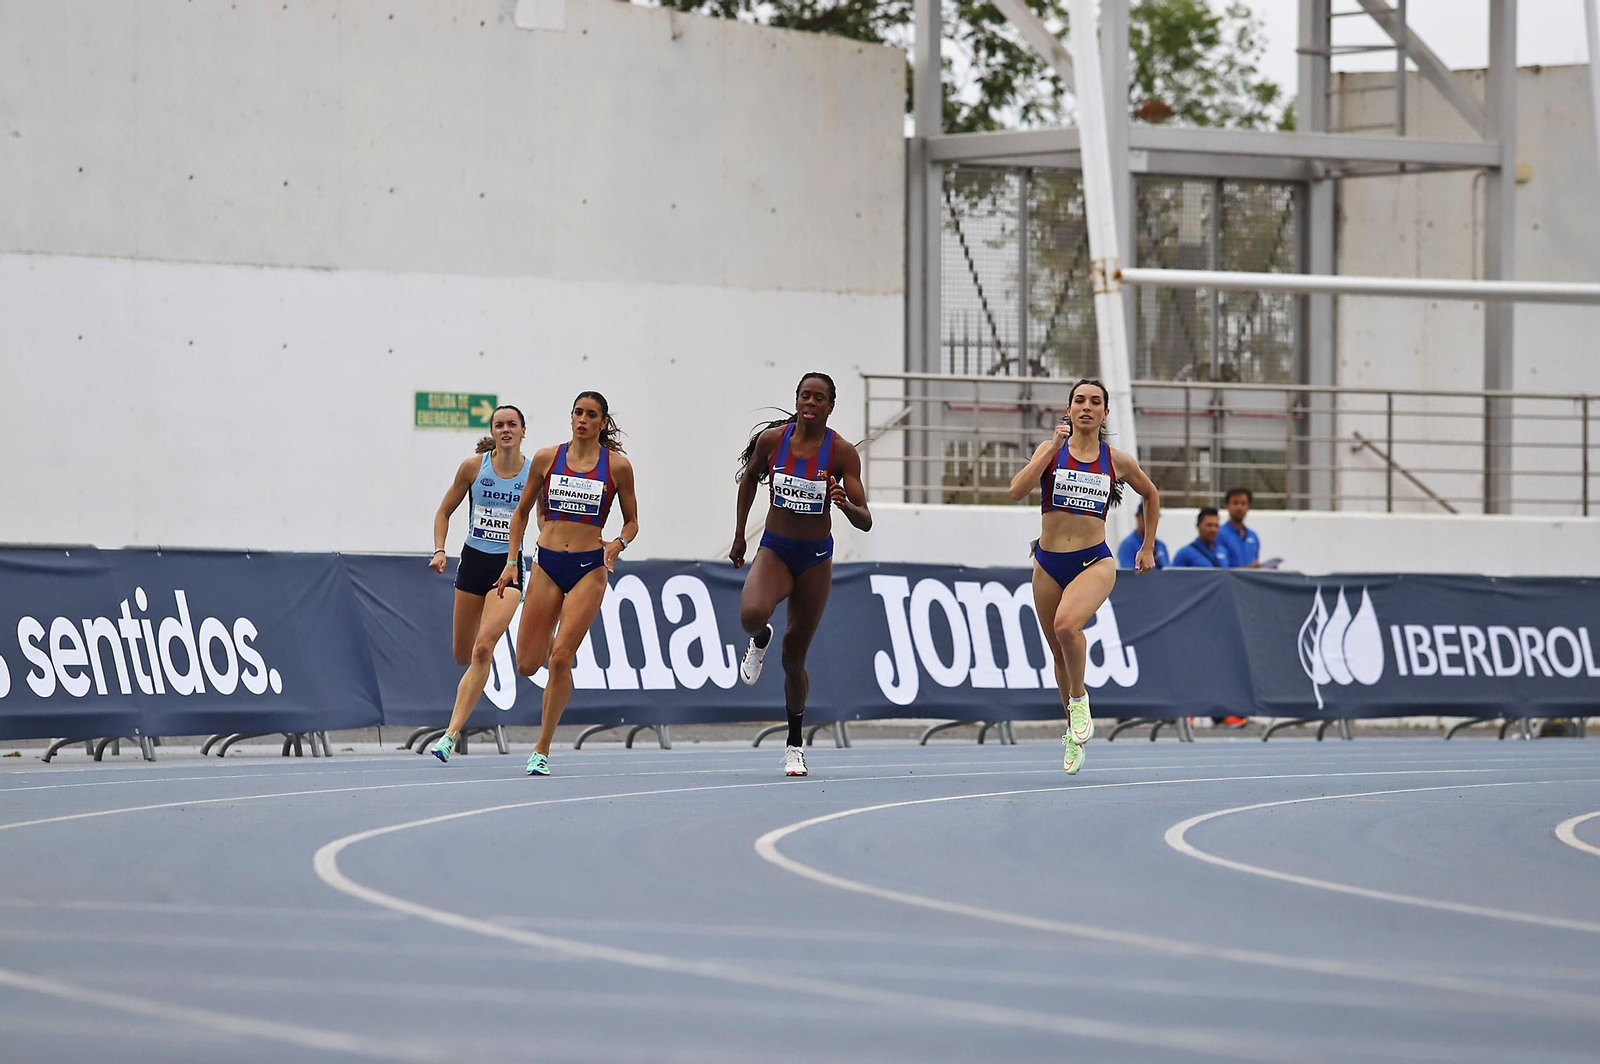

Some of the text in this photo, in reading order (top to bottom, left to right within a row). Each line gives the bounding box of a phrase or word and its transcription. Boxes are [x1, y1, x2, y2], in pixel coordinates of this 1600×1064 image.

[549, 488, 600, 501] HERNANDEZ
[774, 485, 823, 500] BOKESA
[1055, 482, 1108, 497] SANTIDRIAN
[480, 517, 510, 529] PARR
[17, 586, 283, 698] sentidos.
